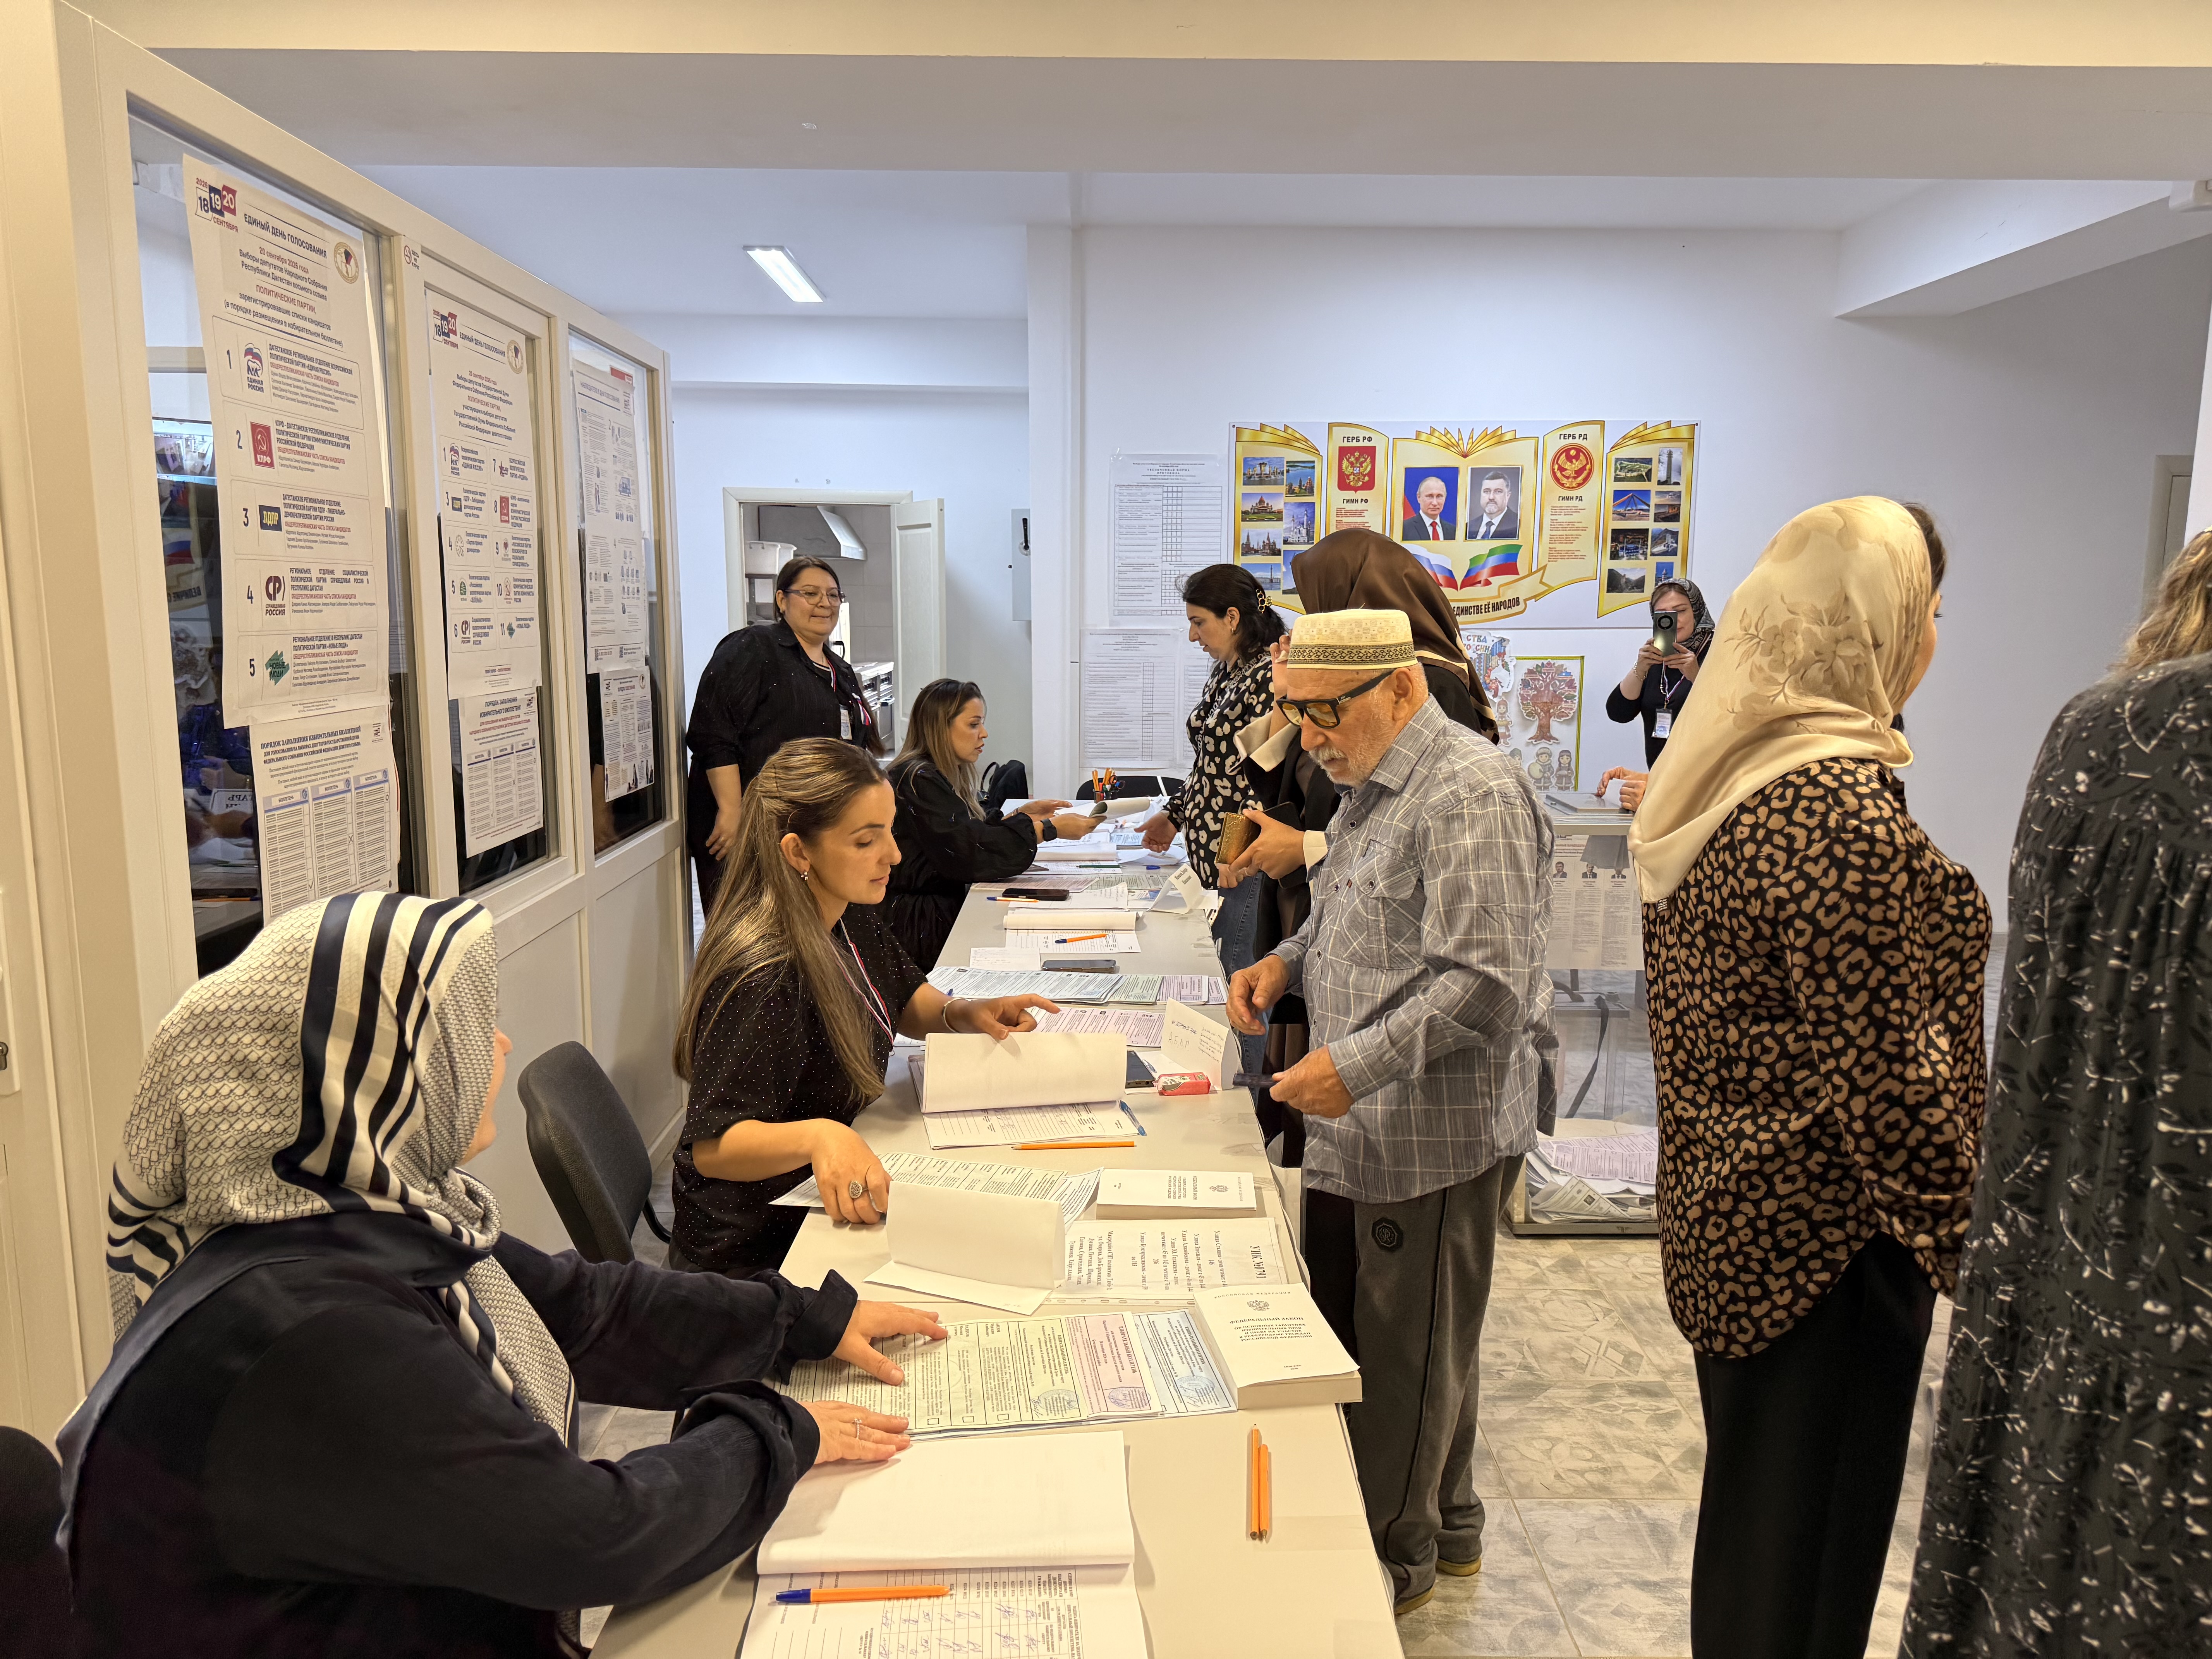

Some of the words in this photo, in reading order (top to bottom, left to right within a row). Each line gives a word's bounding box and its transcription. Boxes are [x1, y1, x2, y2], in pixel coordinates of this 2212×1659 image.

[196, 178, 208, 188] 2026
[198, 196, 209, 213] 18
[210, 192, 221, 211] 19
[223, 190, 234, 210] 20
[213, 216, 238, 232] СЕНТЯБРЯ
[244, 213, 270, 233] ЕДИНЫЙ
[271, 226, 286, 240] ДЕНЬ
[288, 234, 326, 259] ГОЛОСОВАНИЯ
[259, 247, 265, 255] 20
[266, 251, 287, 264] сентября
[288, 259, 298, 269] 2026
[299, 265, 309, 274] года
[239, 249, 259, 263] Выборы
[260, 259, 283, 273] депутатов
[284, 268, 307, 283] Народного
[308, 277, 327, 291] Собрания
[242, 260, 270, 278] Республики
[272, 272, 292, 286] Дагестан
[293, 282, 312, 295] восьмого
[313, 290, 327, 301] созыва
[256, 285, 296, 306] ПОЛИТИЧЕСКИЕ
[297, 300, 316, 314] ПАРТИИ,
[435, 324, 441, 337] 18
[441, 320, 448, 333] 19
[448, 317, 455, 331] 20
[227, 350, 231, 369] 1
[247, 377, 263, 385] ЕДИНАЯ
[248, 383, 264, 393] РОССИЯ
[236, 430, 242, 449] 2
[1578, 433, 1588, 441] РД
[257, 454, 271, 464] КПРФ
[443, 447, 446, 461] 1
[493, 459, 496, 472] 7
[446, 492, 449, 506] 3
[494, 500, 497, 513] 8
[243, 508, 249, 527] 3
[263, 511, 278, 526] ЛДПР
[449, 537, 452, 551] 4
[496, 542, 499, 555] 9
[452, 580, 455, 594] 5
[497, 583, 502, 596] 10
[247, 586, 253, 604] 4
[1484, 601, 1490, 613] ЕЁ
[1492, 597, 1520, 612] НАРОДОВ
[454, 624, 457, 637] 6
[500, 623, 505, 635] 11
[250, 658, 255, 677] 5
[269, 670, 283, 678] ЛЮДИ
[1250, 1246, 1262, 1259] УИК
[1253, 1261, 1266, 1278] №0791
